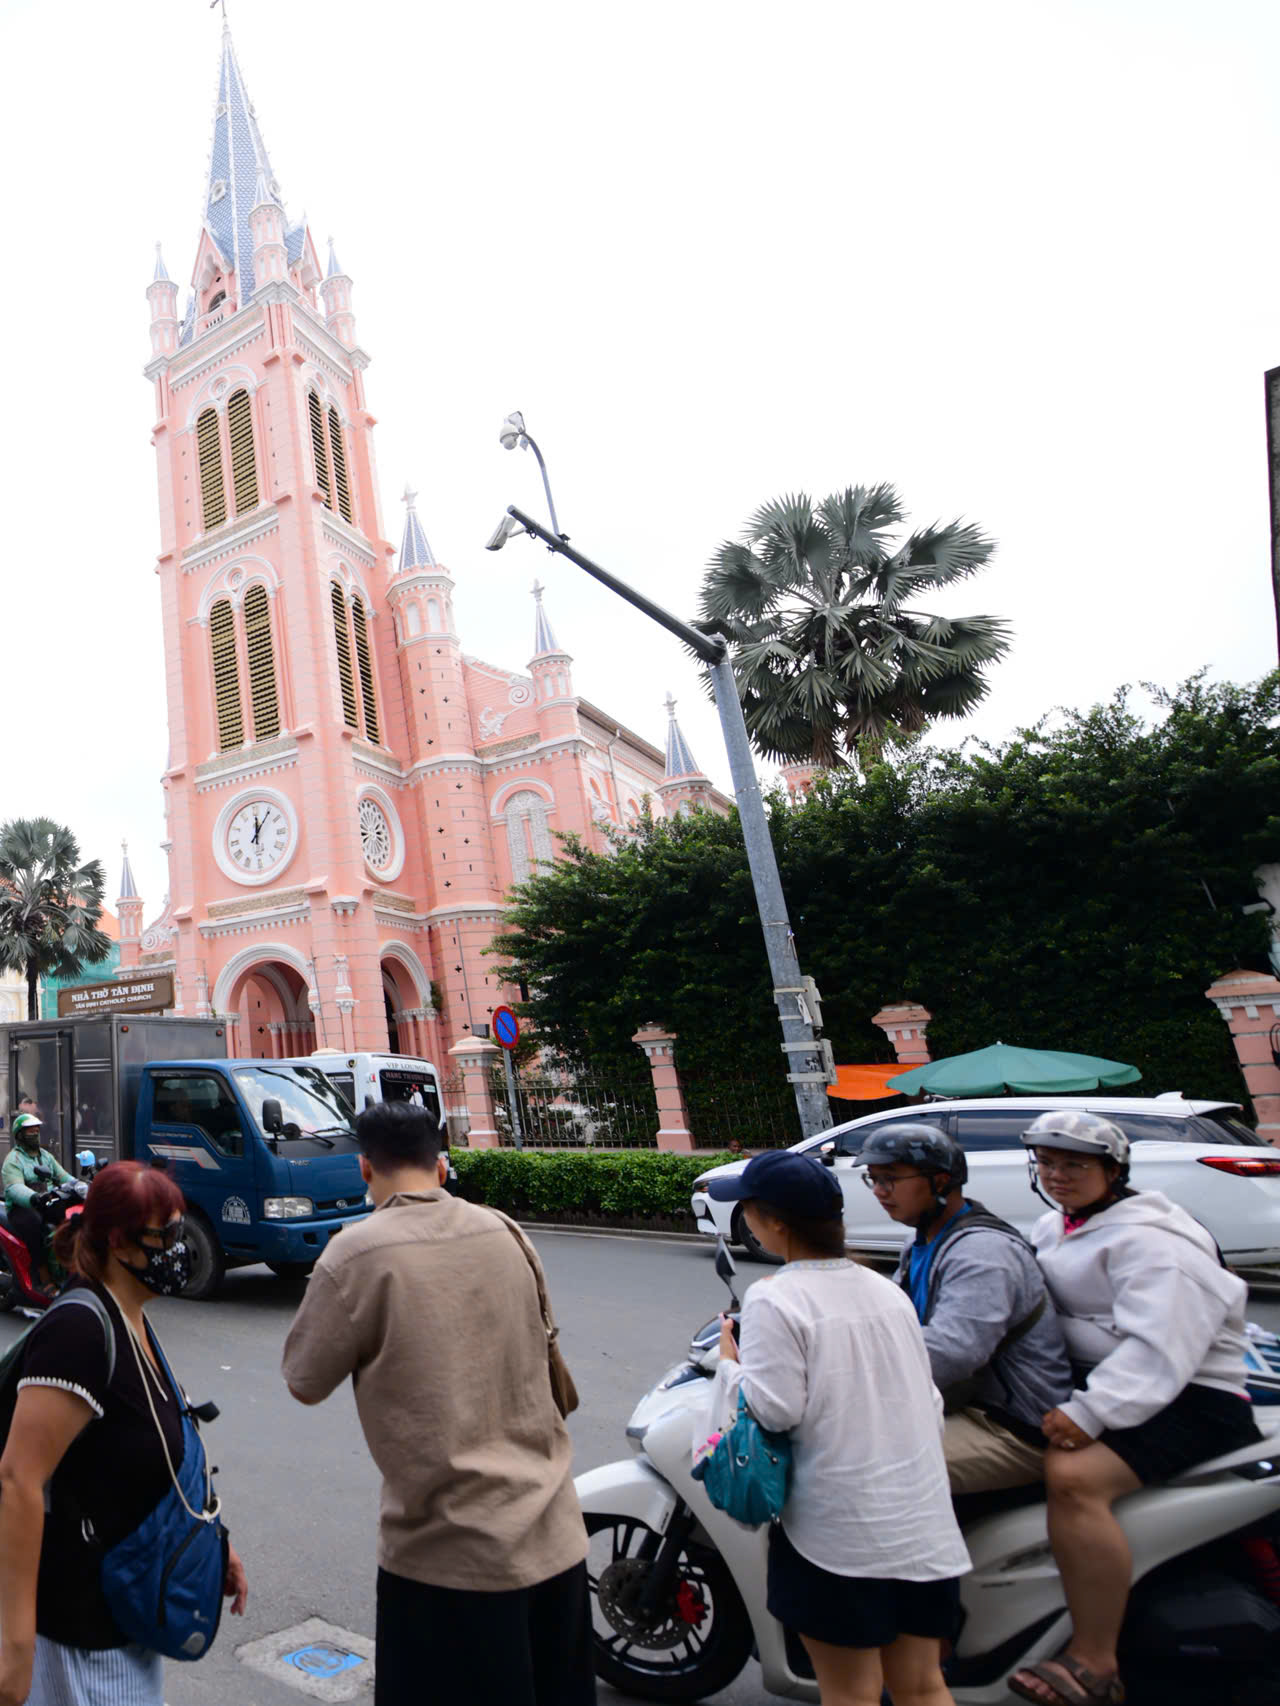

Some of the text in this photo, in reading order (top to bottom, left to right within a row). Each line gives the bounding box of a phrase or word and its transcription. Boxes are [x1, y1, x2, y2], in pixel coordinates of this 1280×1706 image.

[72, 983, 155, 1002] NHÀ THỜ TÂN ĐỊNH
[127, 994, 152, 1003] CHURCH
[400, 1063, 428, 1072] LOUNGE
